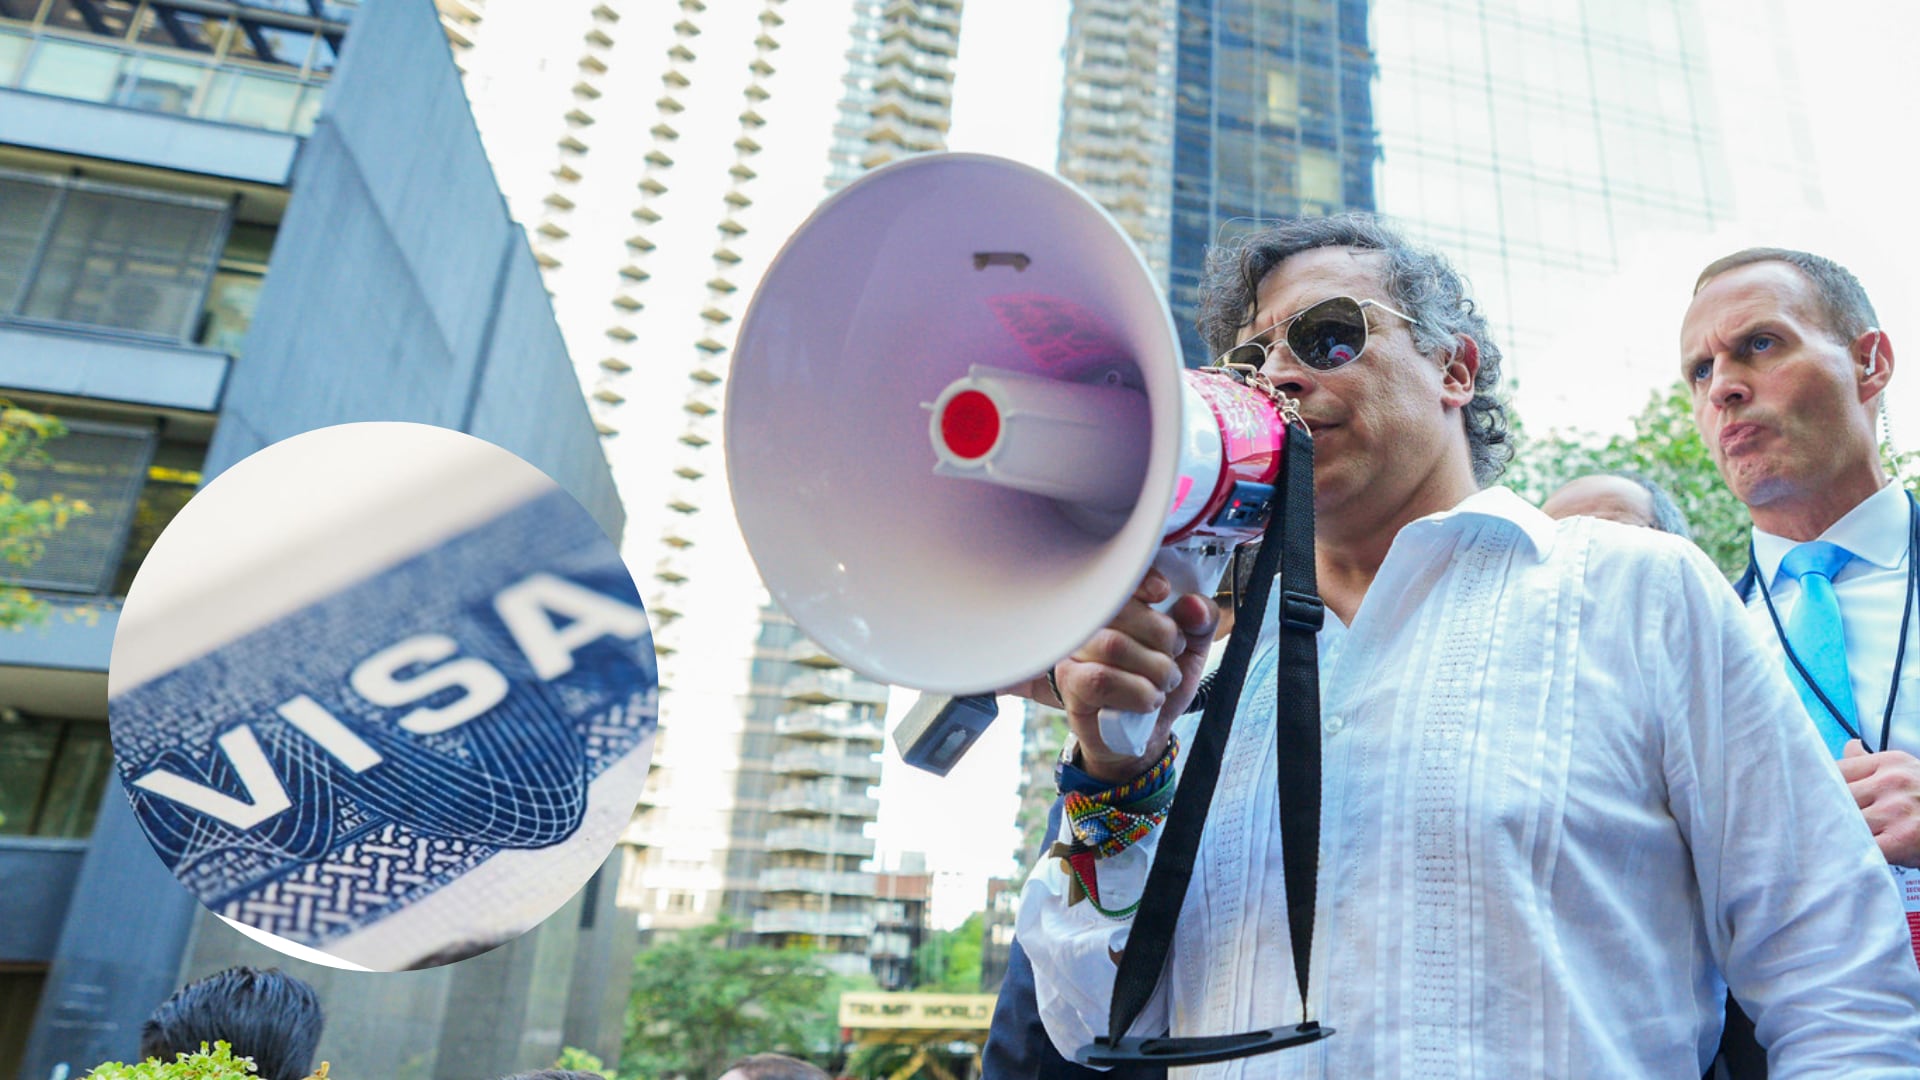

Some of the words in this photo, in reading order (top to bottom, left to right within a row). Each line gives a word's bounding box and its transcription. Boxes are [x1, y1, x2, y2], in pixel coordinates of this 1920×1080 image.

[132, 572, 648, 831] VISA
[848, 1002, 912, 1016] TRUMP
[922, 1004, 988, 1019] WORLD
